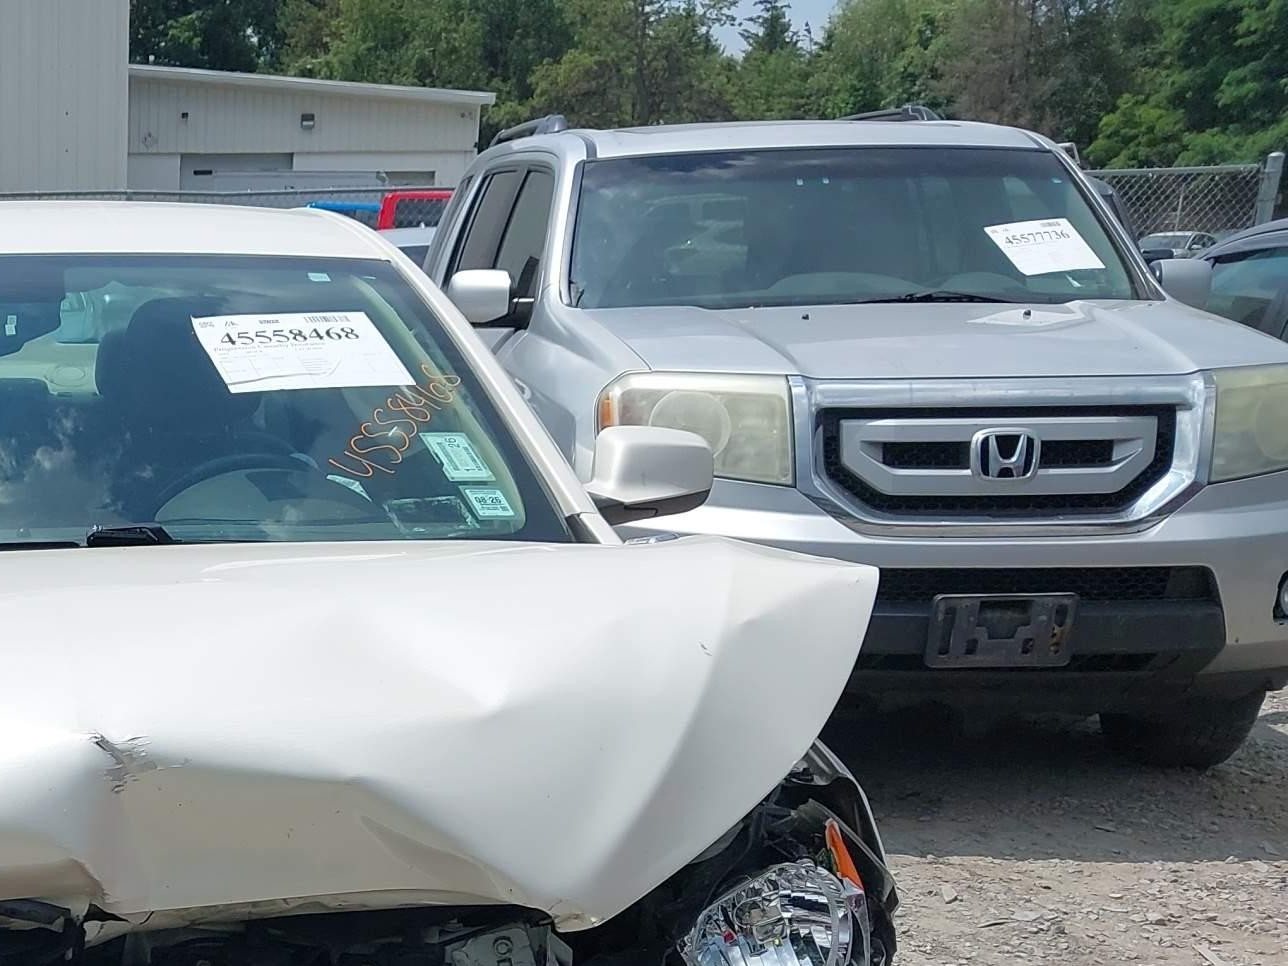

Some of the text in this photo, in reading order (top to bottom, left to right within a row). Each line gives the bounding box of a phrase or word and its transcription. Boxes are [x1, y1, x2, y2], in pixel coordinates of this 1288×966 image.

[1005, 230, 1070, 245] 45577736
[221, 327, 360, 345] 45558468
[328, 363, 461, 477] 45558468
